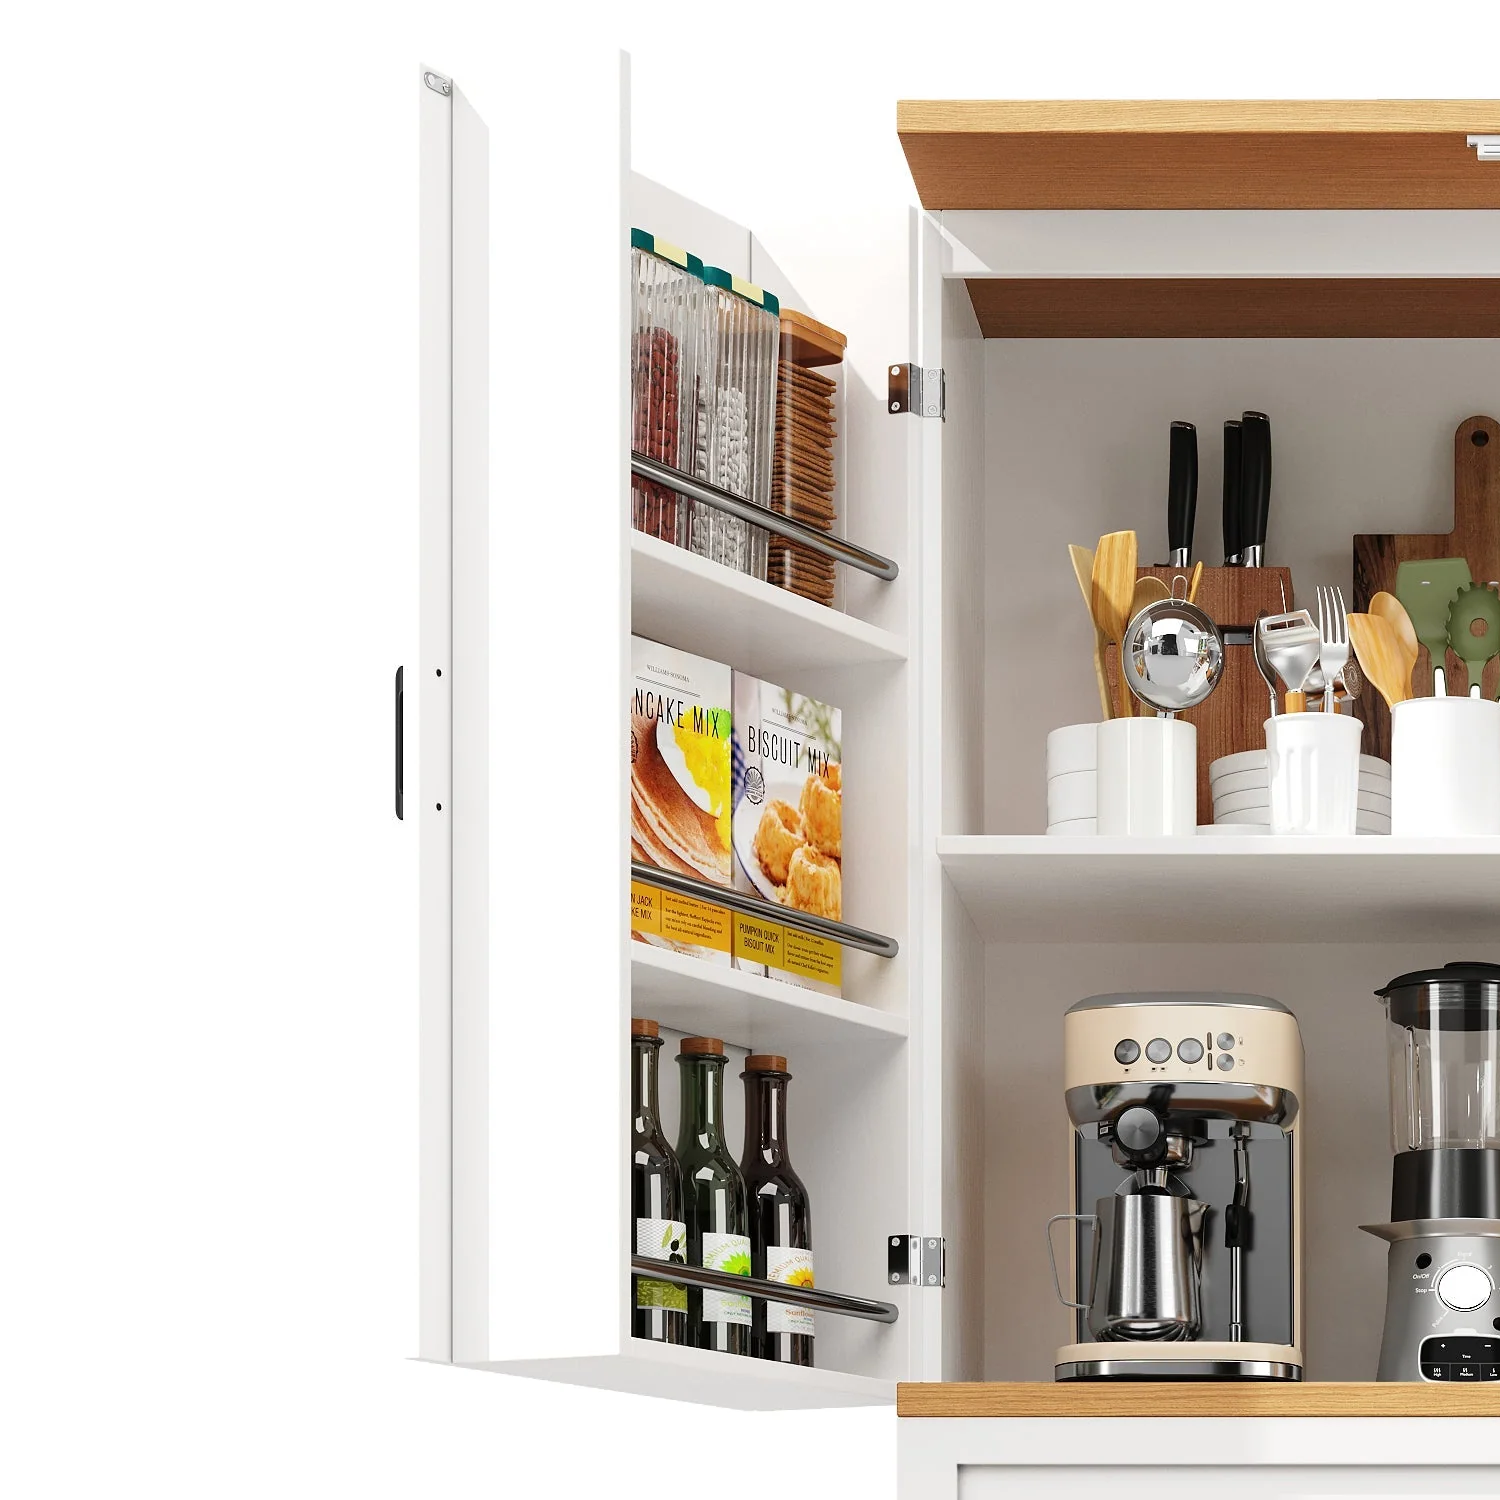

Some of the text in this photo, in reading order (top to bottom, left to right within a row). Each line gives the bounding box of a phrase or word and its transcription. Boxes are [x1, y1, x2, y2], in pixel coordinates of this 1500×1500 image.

[631, 687, 719, 739] NCAKE MIX
[748, 725, 830, 779] BISCUIT MIX
[637, 895, 653, 908] JACK
[640, 909, 653, 920] MIX
[739, 922, 780, 944] PUMPKIN QUICK
[765, 942, 775, 955] MIX
